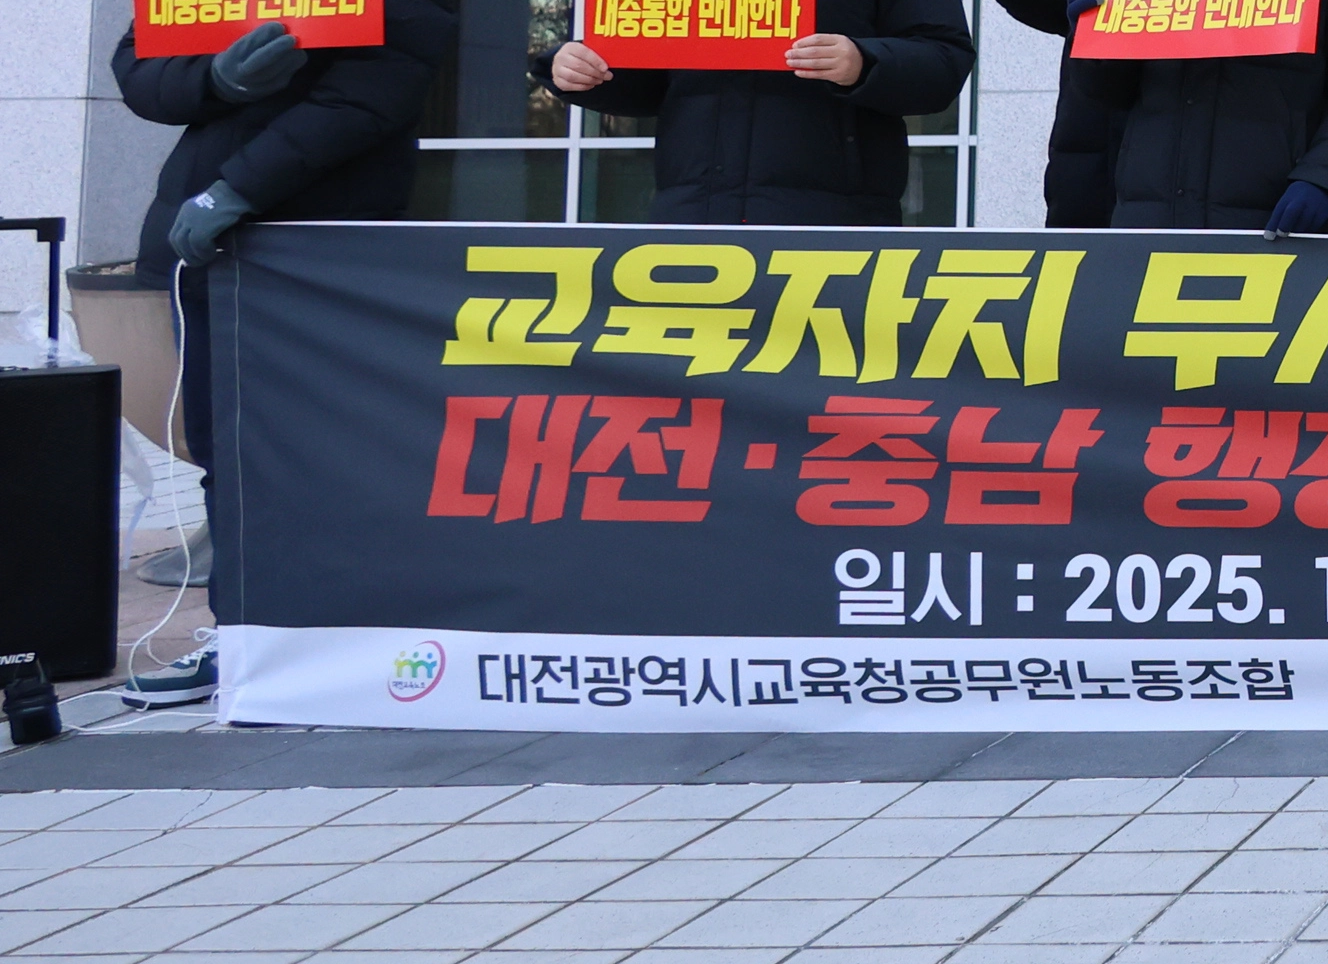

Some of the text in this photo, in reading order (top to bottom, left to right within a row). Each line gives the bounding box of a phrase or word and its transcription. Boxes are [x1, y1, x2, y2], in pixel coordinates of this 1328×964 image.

[443, 244, 1086, 387] 교육자치
[835, 549, 982, 625] 일시
[1065, 554, 1284, 623] 2025.
[0, 652, 36, 665] NICS
[479, 655, 1294, 706] 대전광역시교육청공무원노동조합
